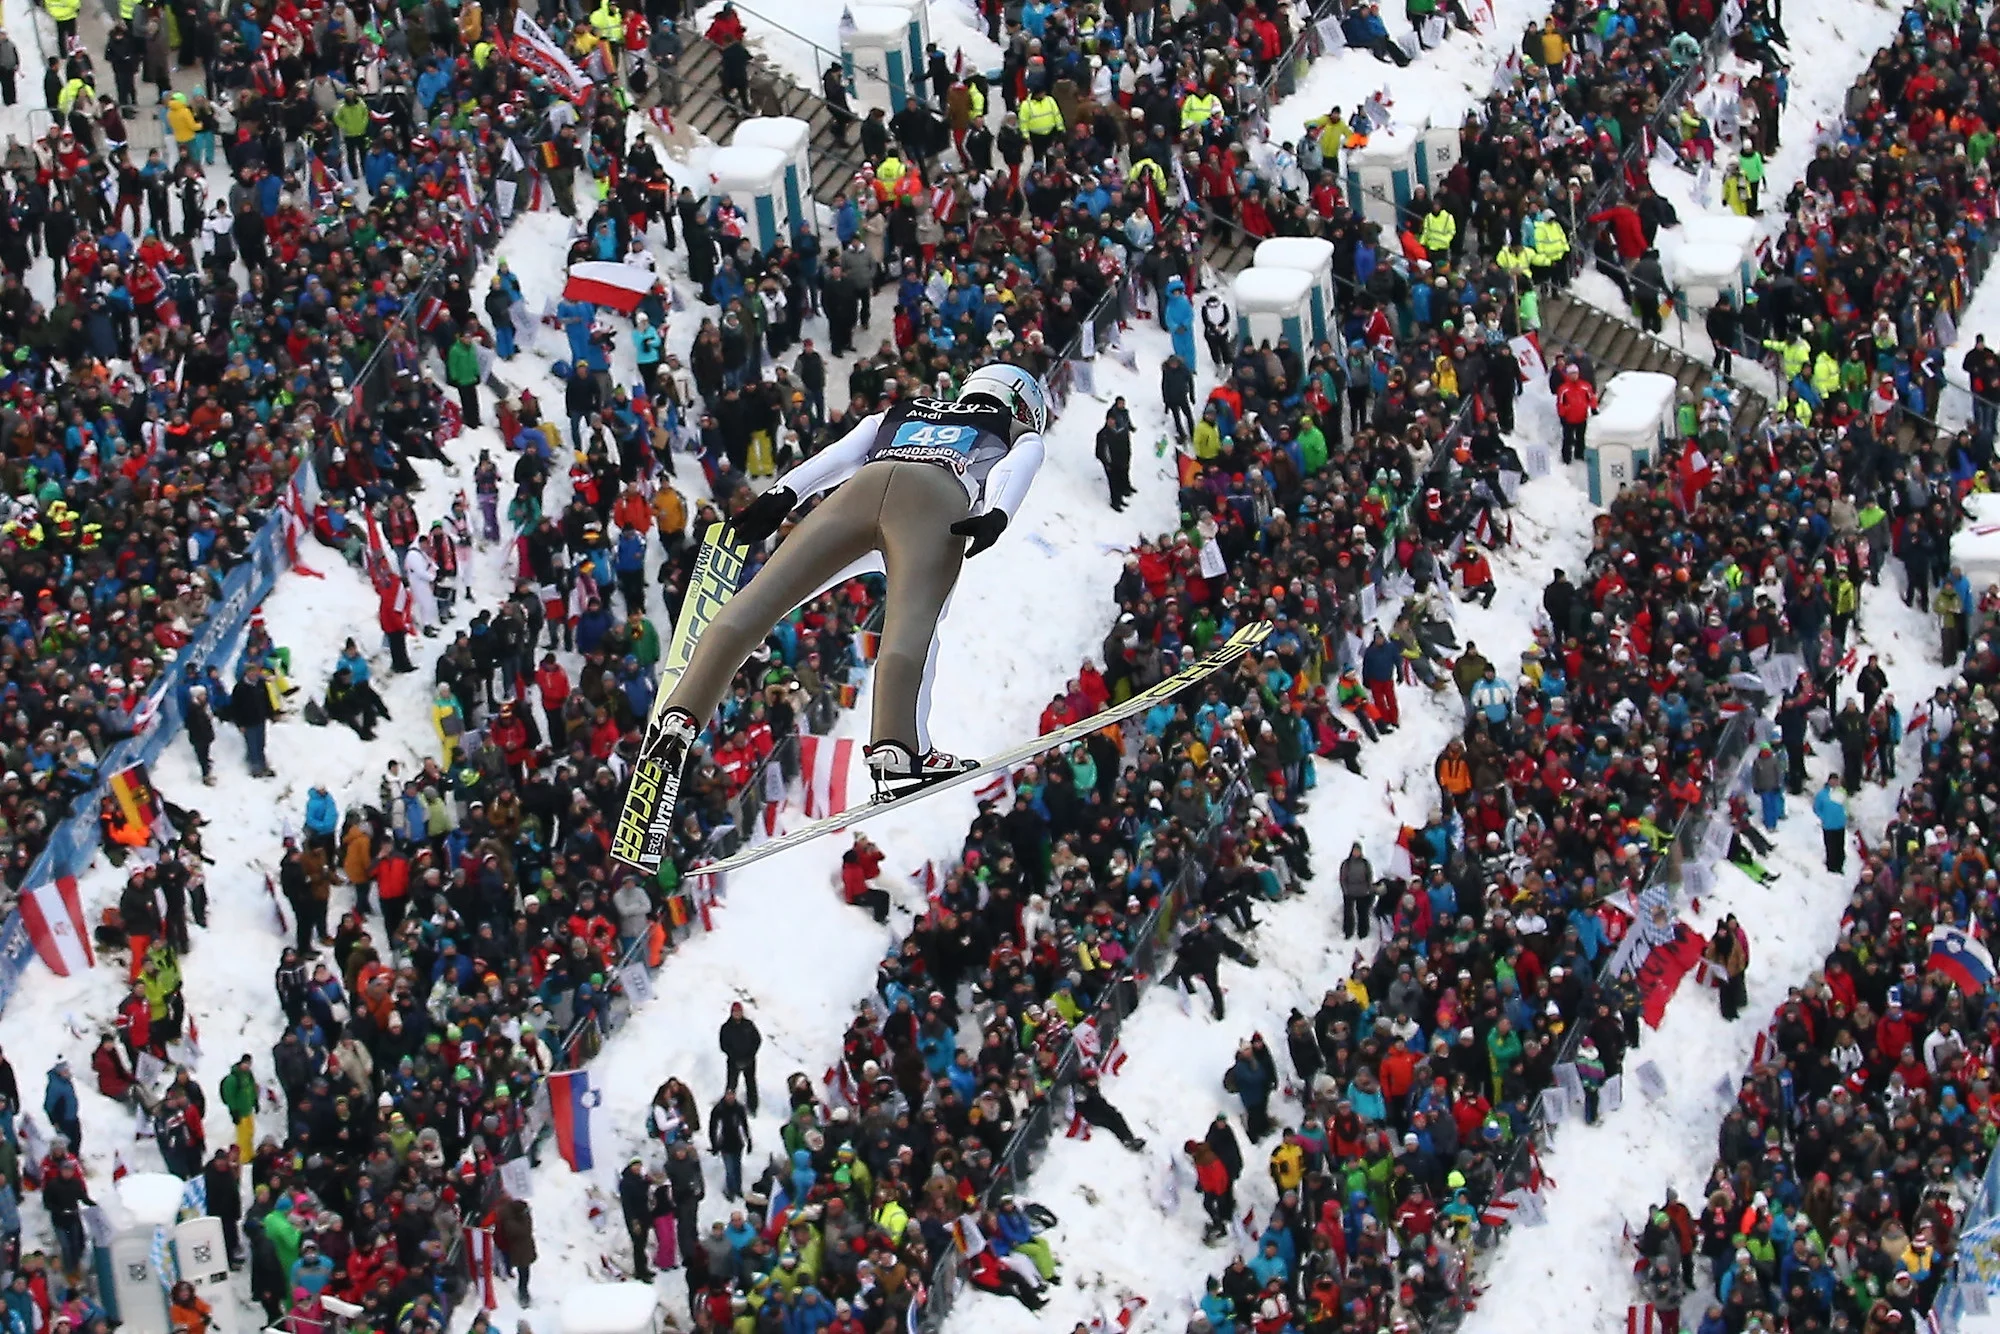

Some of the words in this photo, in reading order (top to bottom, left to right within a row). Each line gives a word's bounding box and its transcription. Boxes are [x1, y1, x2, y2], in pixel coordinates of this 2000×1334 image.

[906, 409, 942, 420] Audi
[907, 425, 961, 446] 49
[612, 760, 662, 862] FISCHER
